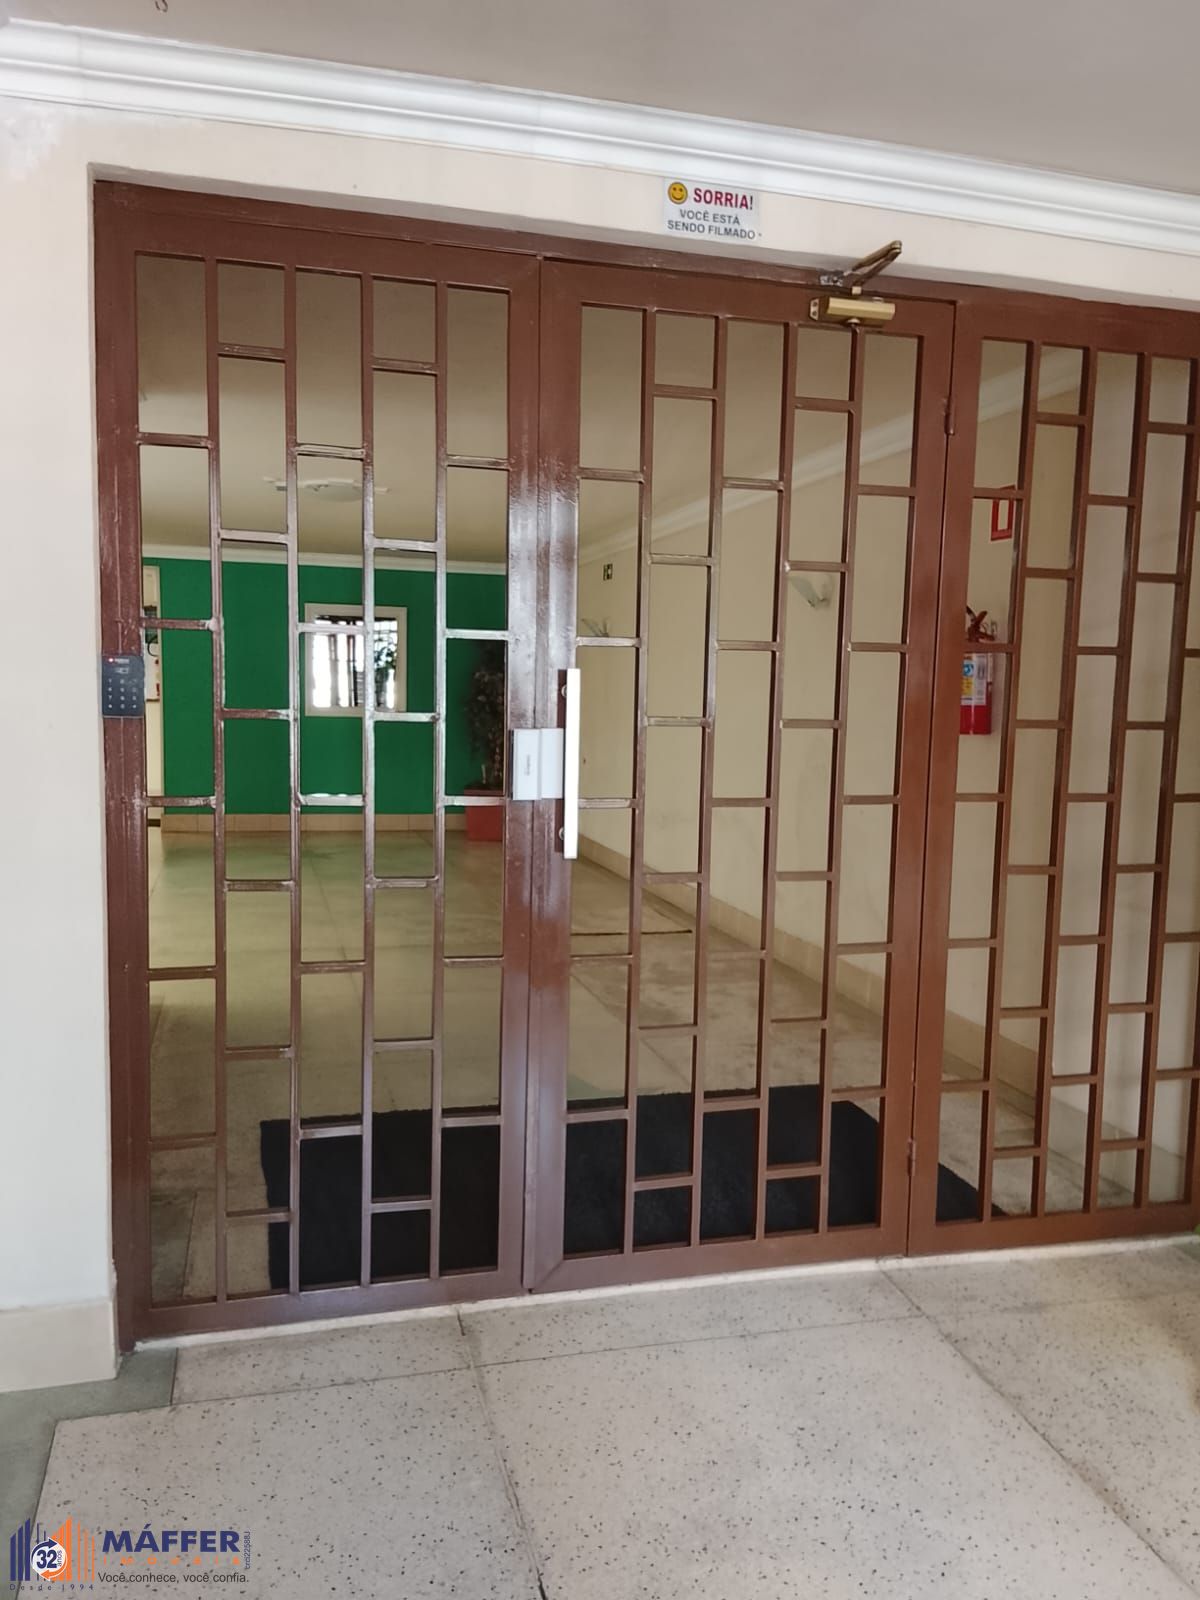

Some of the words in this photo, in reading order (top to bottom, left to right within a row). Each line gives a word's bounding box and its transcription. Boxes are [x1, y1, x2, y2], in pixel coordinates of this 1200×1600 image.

[693, 187, 754, 211] SORRIA!
[679, 208, 710, 222] VOCÊ
[712, 213, 741, 226] ESTÁ
[667, 219, 705, 234] SENDO
[708, 225, 756, 240] FILMADO
